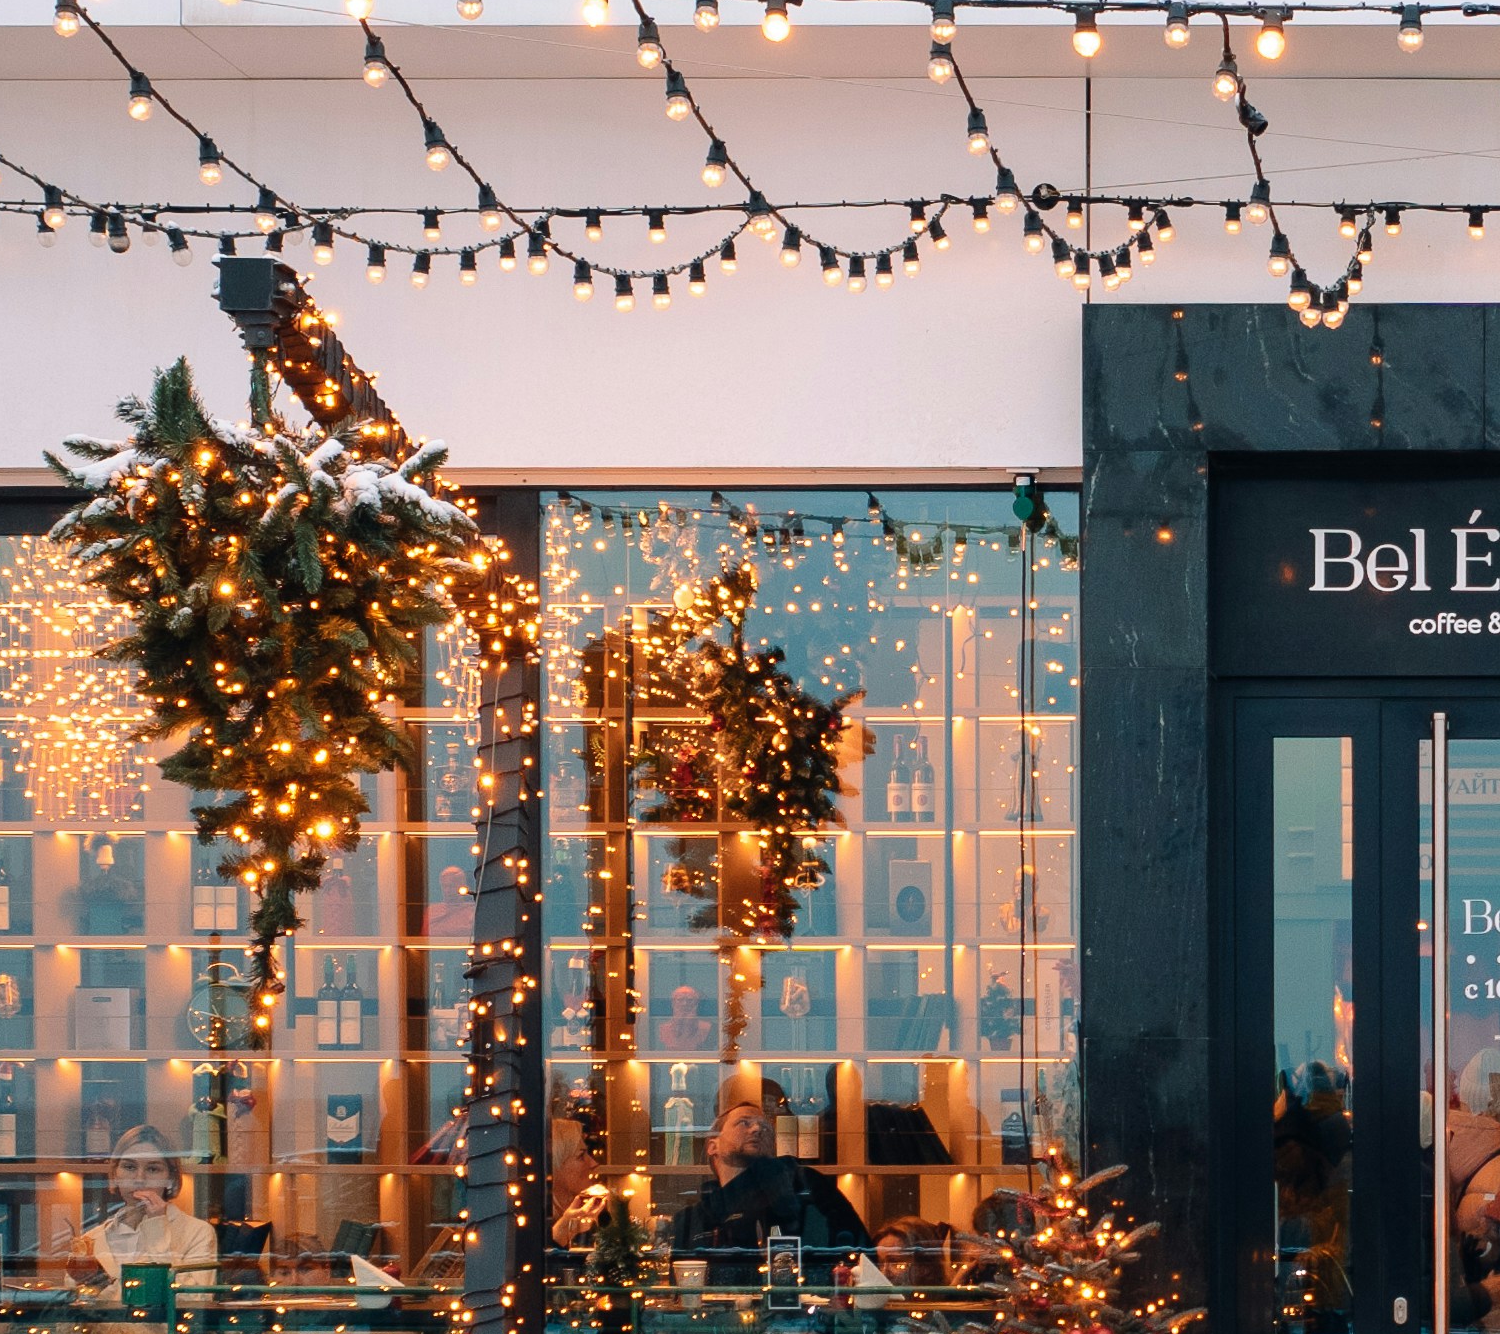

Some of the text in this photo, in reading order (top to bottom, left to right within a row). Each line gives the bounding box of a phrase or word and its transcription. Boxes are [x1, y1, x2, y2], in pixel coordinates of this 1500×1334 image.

[1308, 527, 1430, 594] Bel
[1408, 611, 1482, 636] coffee
[1464, 984, 1479, 1000] с
